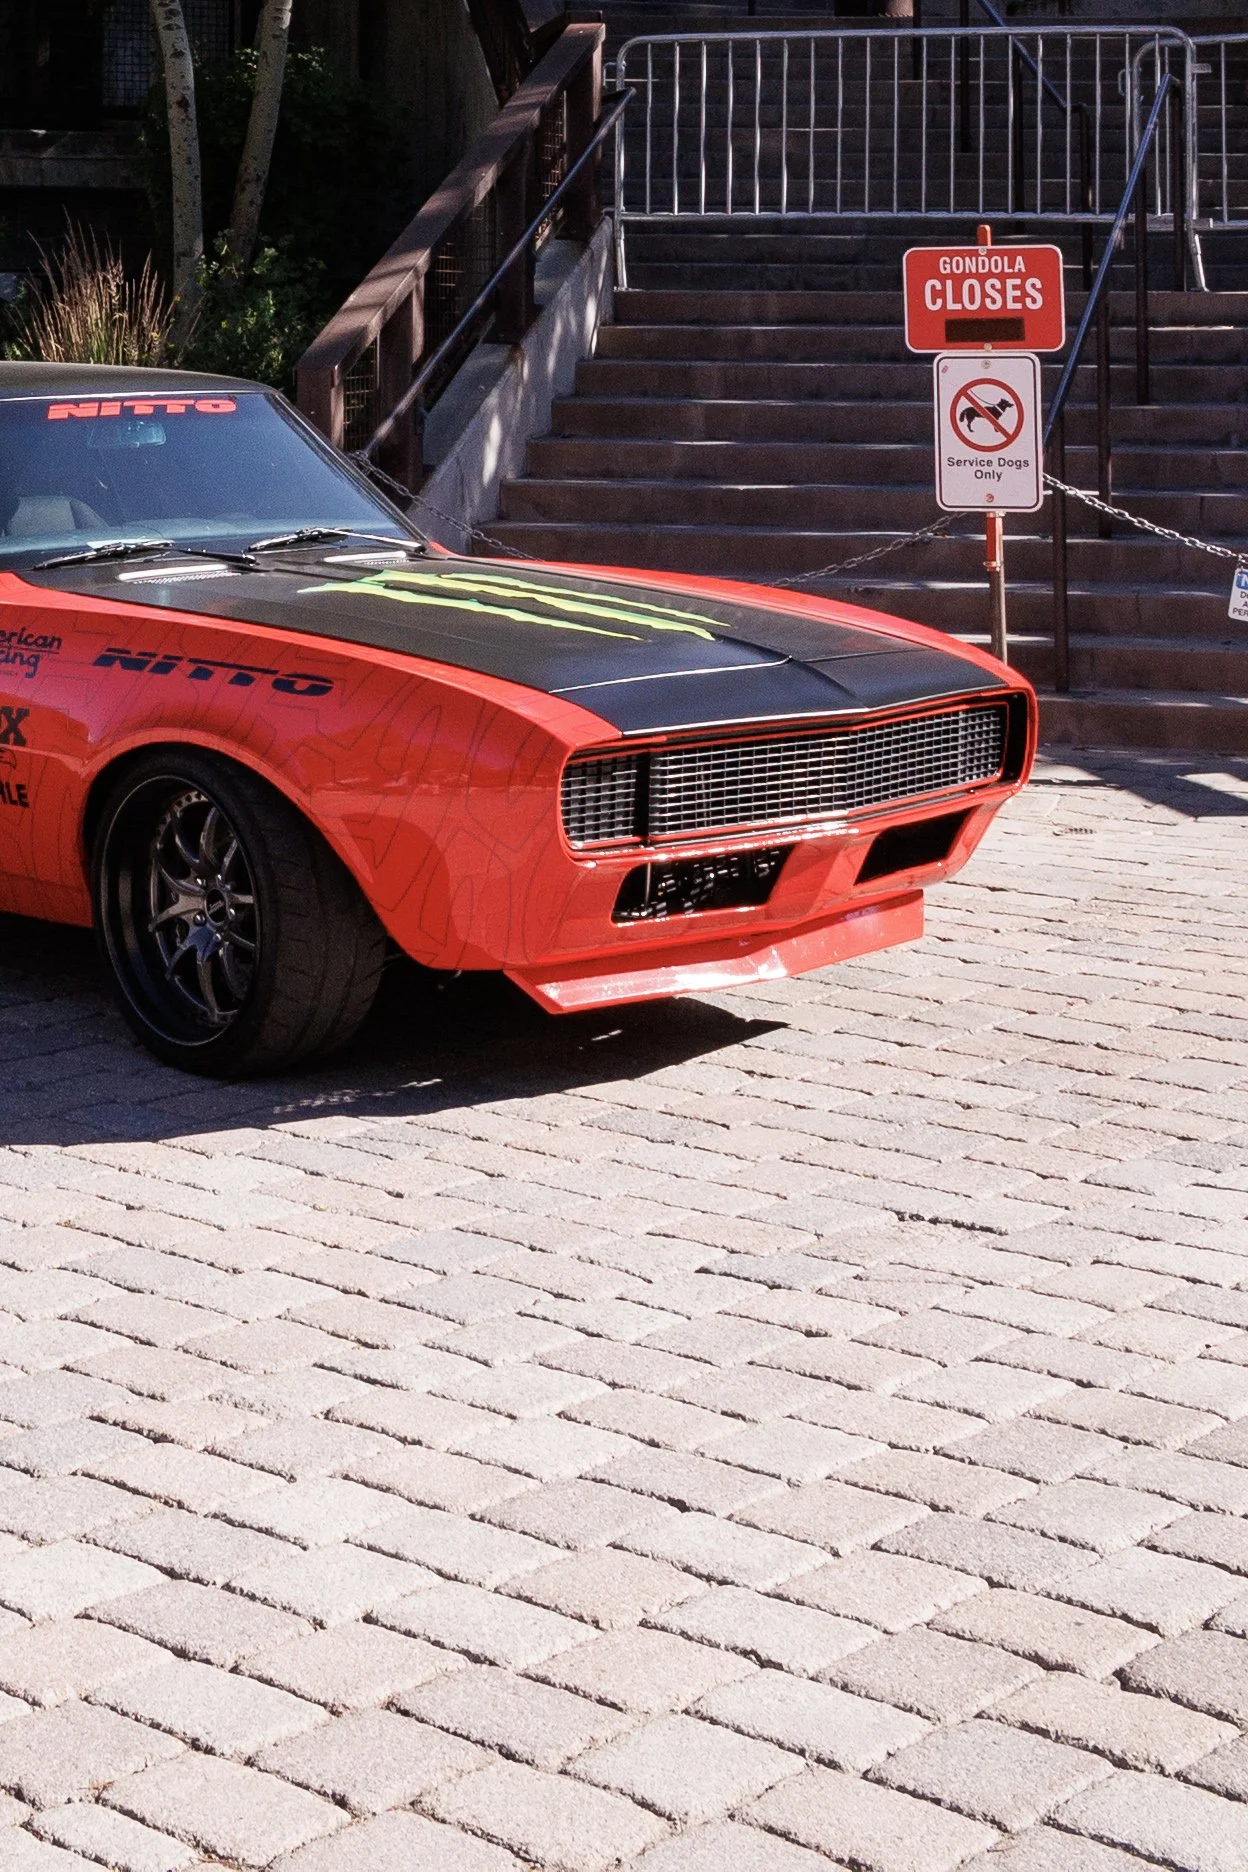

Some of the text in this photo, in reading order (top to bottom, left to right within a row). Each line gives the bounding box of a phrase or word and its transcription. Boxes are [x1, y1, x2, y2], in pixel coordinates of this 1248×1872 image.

[939, 256, 1026, 274] GONDOLA
[924, 278, 1043, 311] CLOSES
[47, 399, 237, 420] NITTO
[947, 457, 1030, 470] Service Dogs
[974, 469, 1003, 482] Only
[92, 647, 334, 697] NITTO
